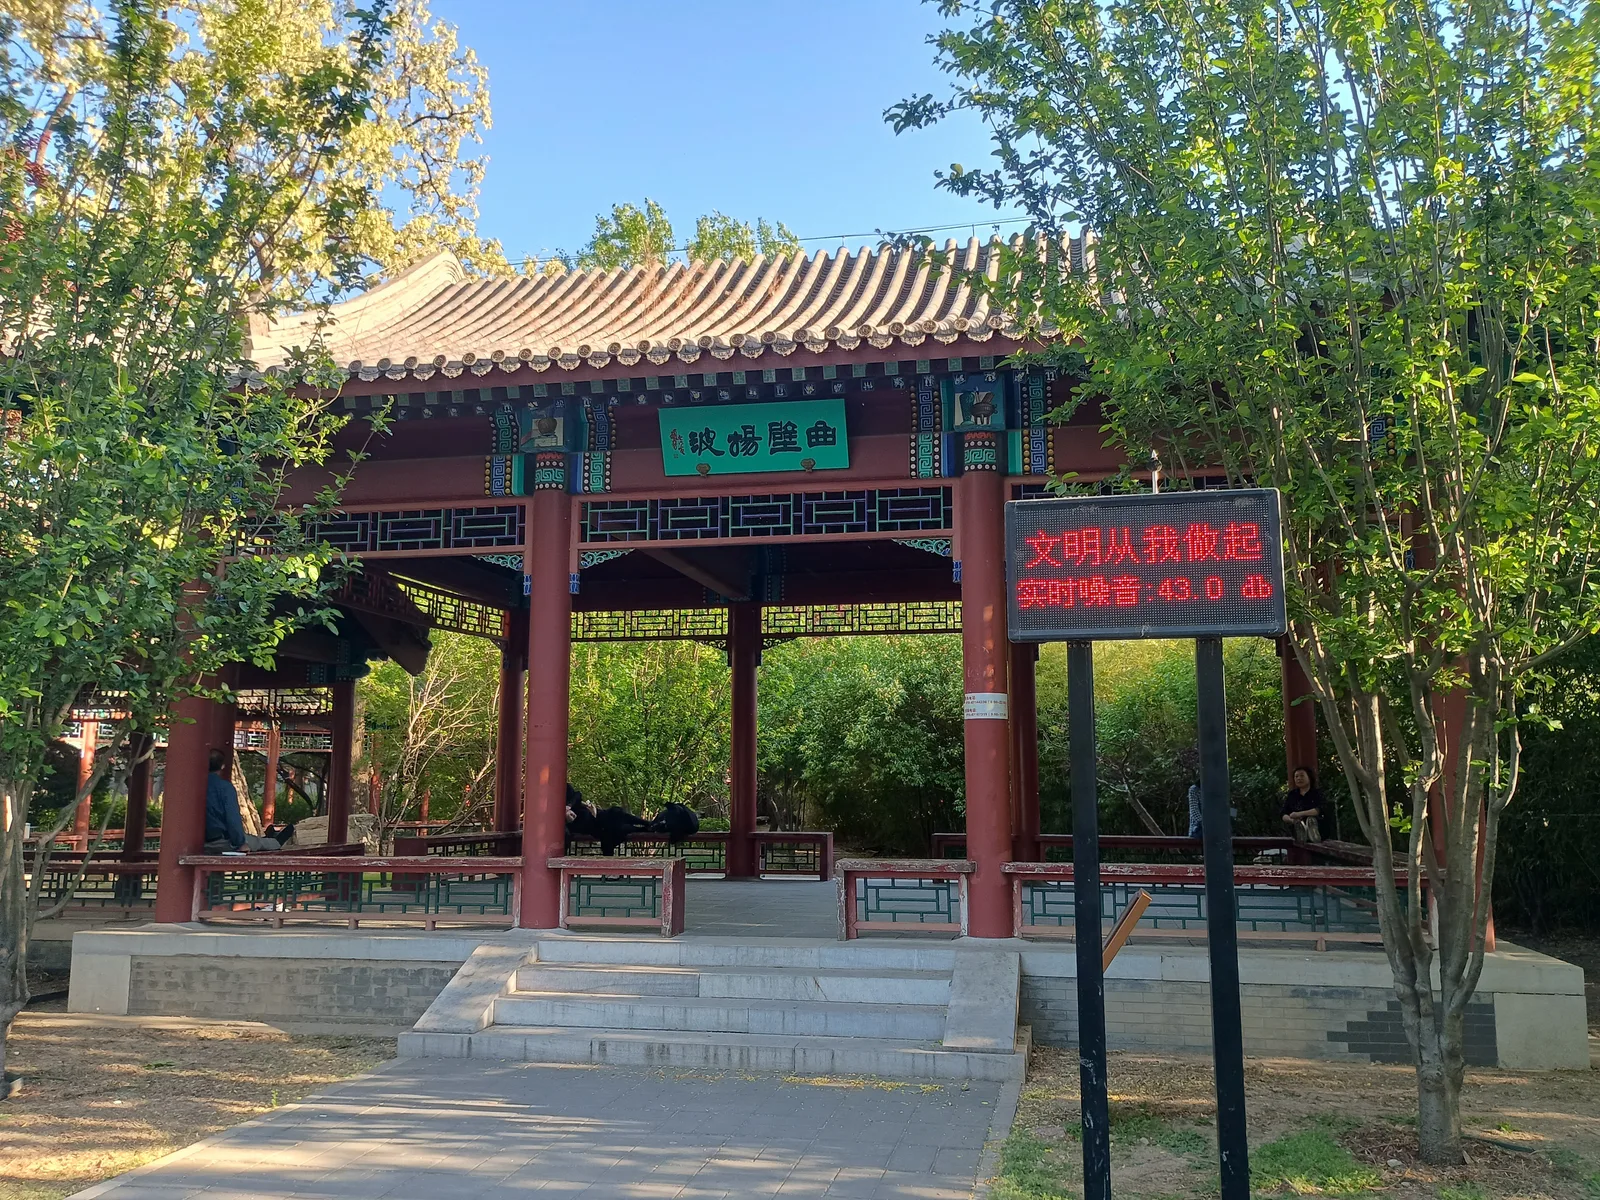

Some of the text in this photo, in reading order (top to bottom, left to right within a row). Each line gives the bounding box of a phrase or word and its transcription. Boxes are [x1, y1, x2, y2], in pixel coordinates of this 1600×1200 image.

[1024, 522, 1263, 569] 文明从我做起
